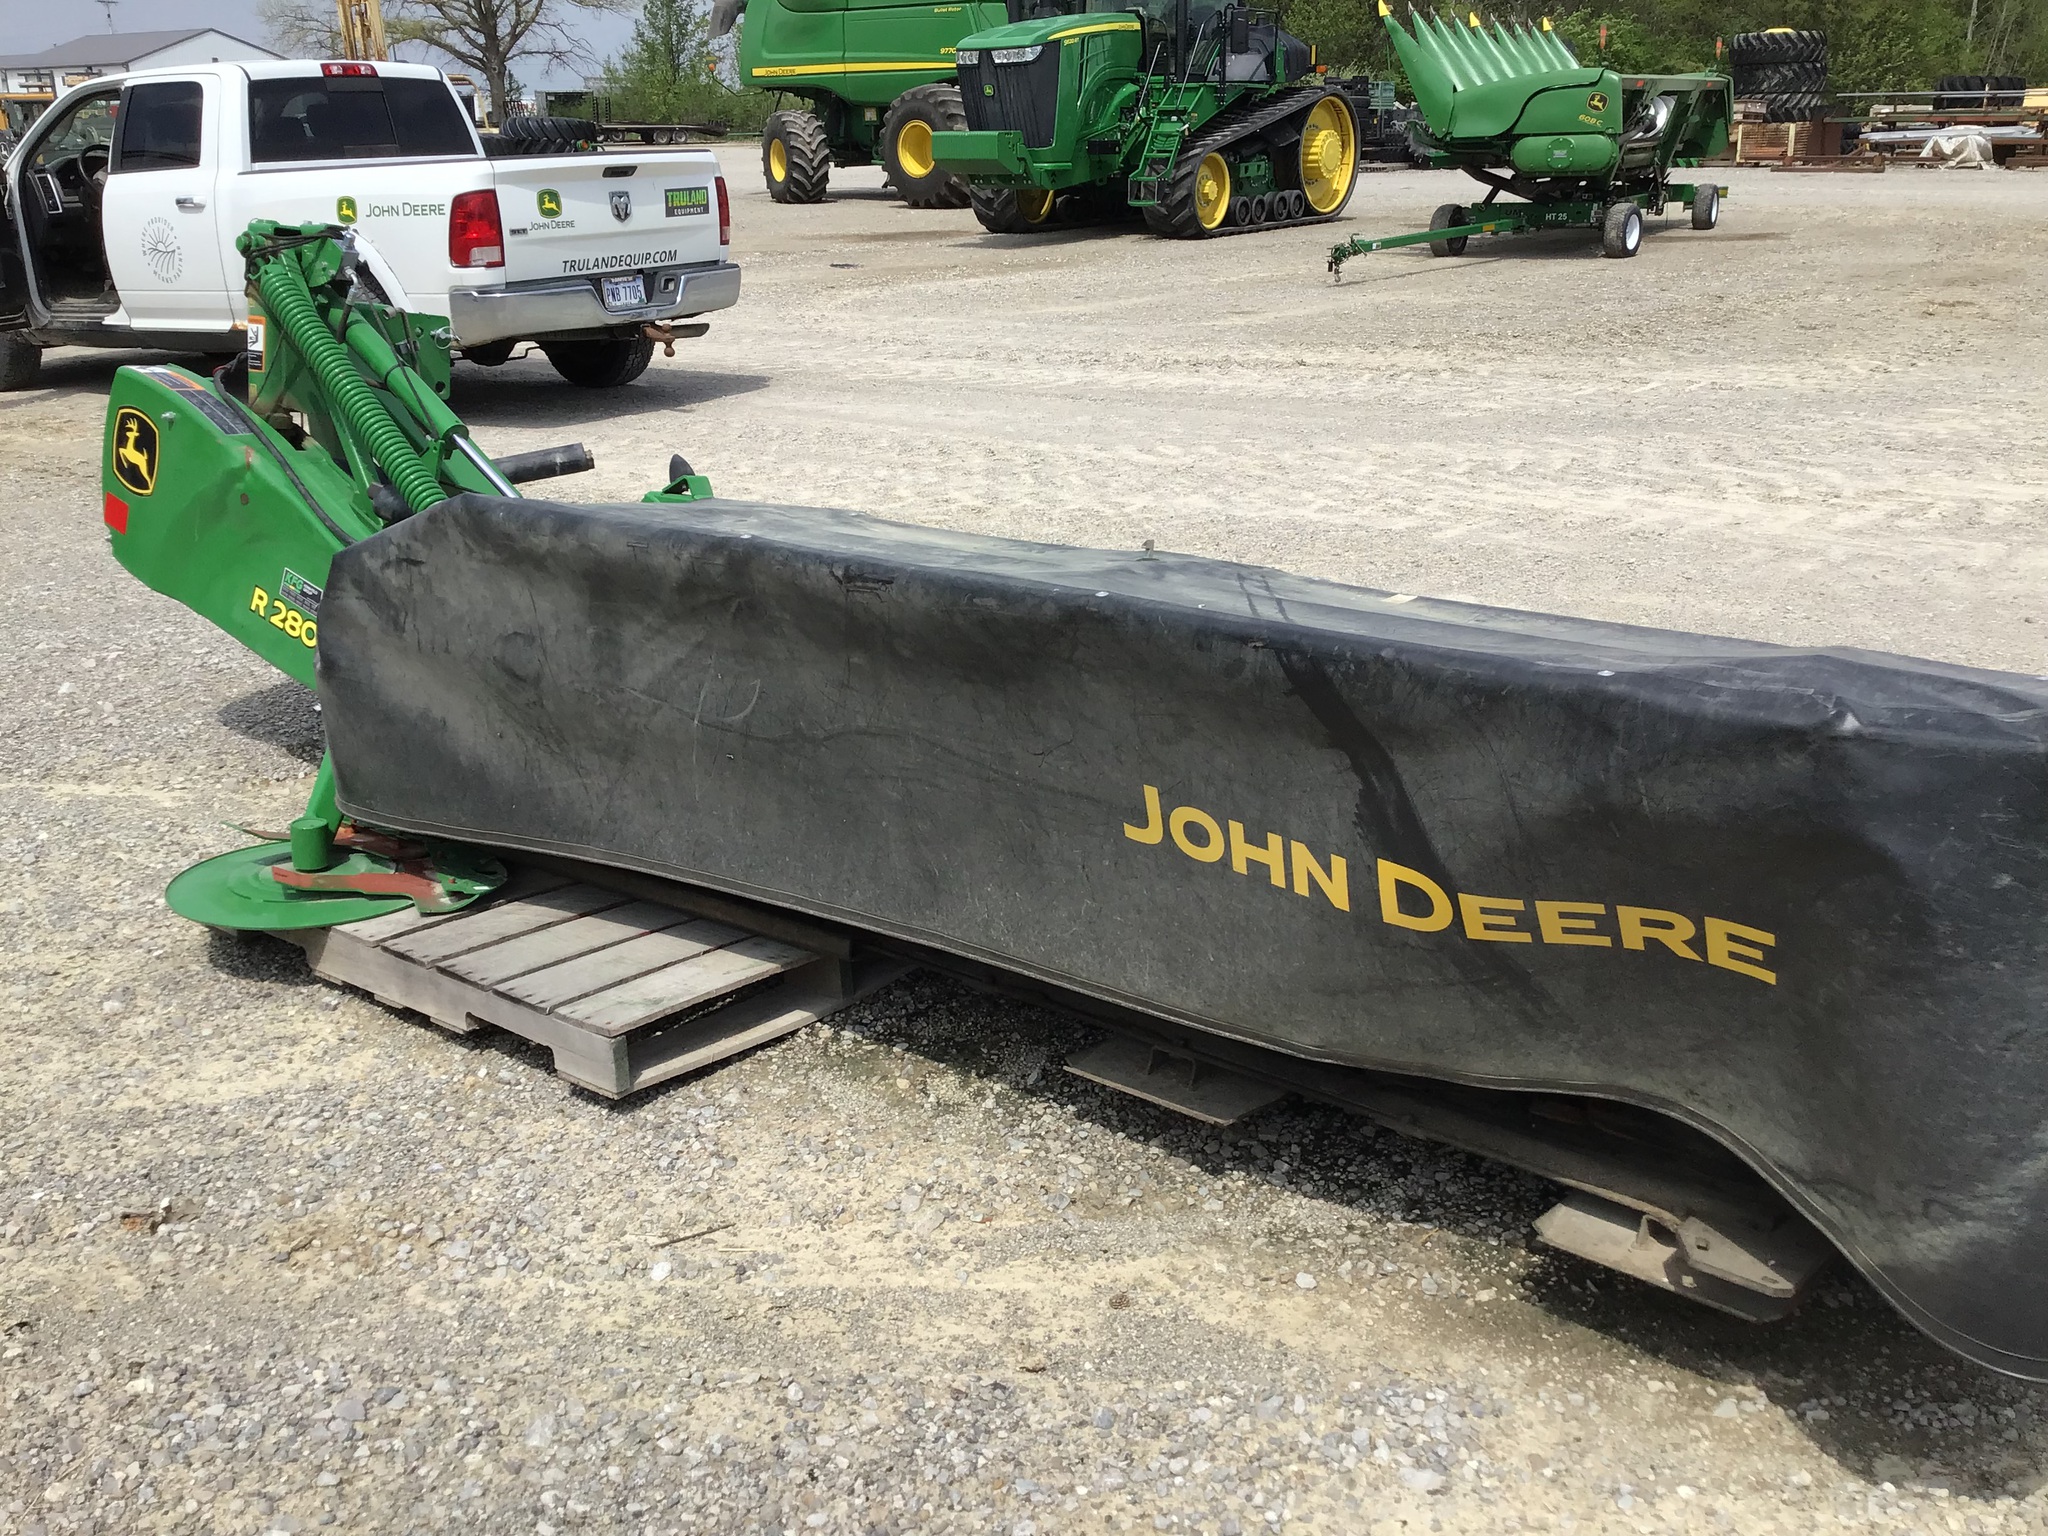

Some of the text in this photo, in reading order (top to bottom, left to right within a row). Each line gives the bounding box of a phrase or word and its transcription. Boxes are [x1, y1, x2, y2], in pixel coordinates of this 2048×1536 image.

[778, 68, 797, 76] DEERE
[666, 189, 707, 207] TRULAND
[366, 202, 446, 218] JOHN DEERE
[673, 207, 704, 215] EQUIPMENT
[1545, 213, 1556, 221] HT
[1557, 212, 1568, 221] 25
[528, 220, 575, 231] JOHN DEERE
[562, 249, 678, 273] TRULANDEQUIP.COM
[622, 284, 643, 301] 7705
[284, 572, 304, 589] KFG
[249, 585, 269, 619] R
[268, 598, 318, 649] 280
[1123, 784, 1778, 986] JOHN DEERE
